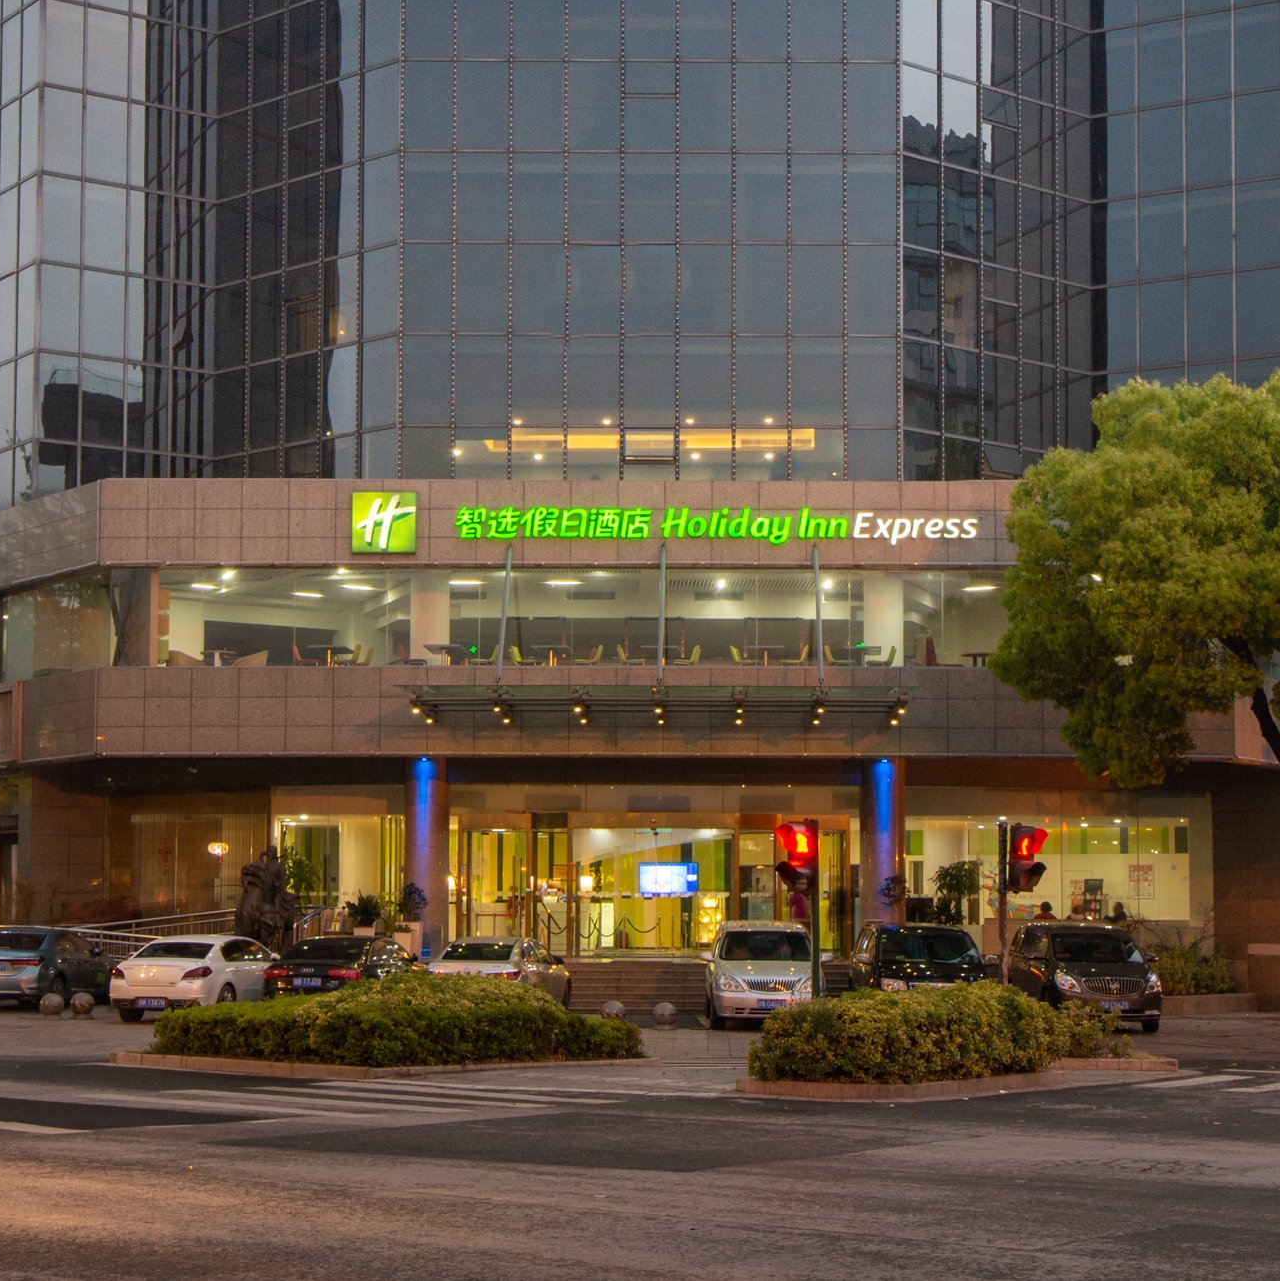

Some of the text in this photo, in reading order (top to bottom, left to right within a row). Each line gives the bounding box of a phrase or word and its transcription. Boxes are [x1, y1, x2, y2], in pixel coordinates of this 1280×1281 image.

[456, 506, 978, 546] 智选假日酒店 Holiday Inn Express
